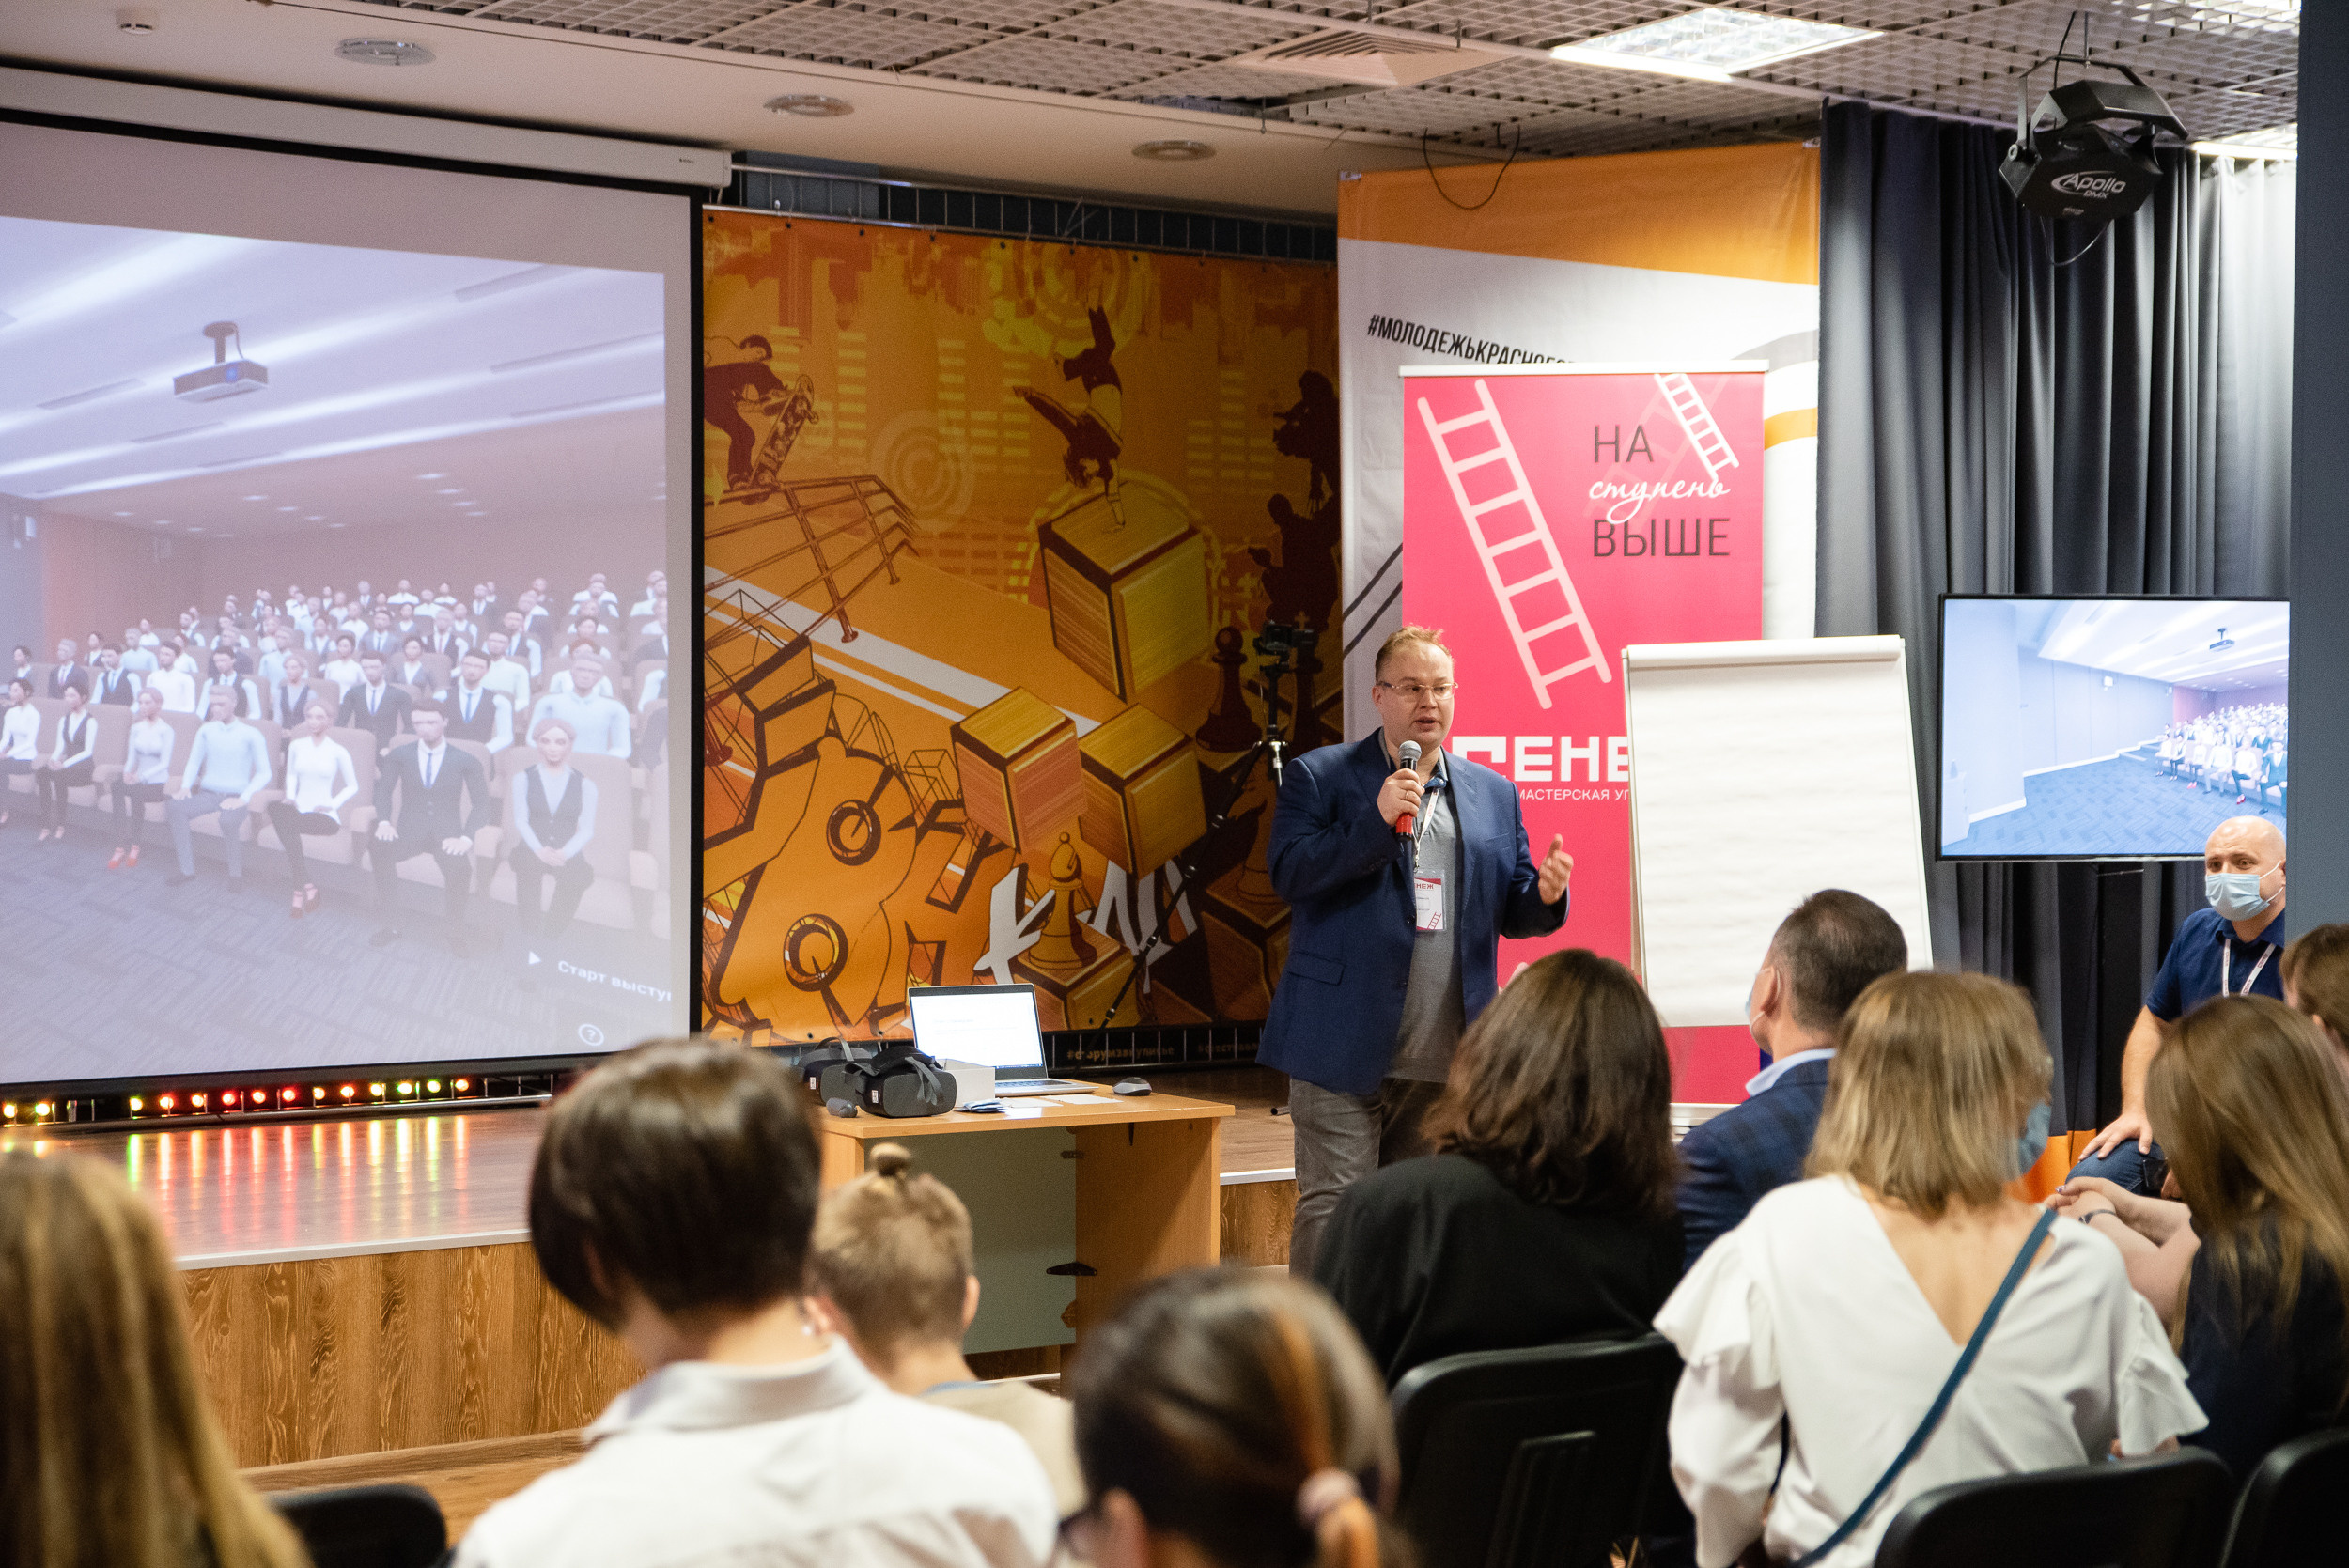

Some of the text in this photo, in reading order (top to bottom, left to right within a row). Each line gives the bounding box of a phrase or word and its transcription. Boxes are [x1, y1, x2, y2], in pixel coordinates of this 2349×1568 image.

[2062, 173, 2127, 194] Apollo
[2083, 190, 2109, 199] DMX
[1594, 425, 1654, 463] НА
[1589, 478, 1732, 525] ступень
[1594, 519, 1731, 557] ВЫШЕ
[1452, 736, 1629, 782] ЕНЕ
[557, 959, 607, 984] Старт
